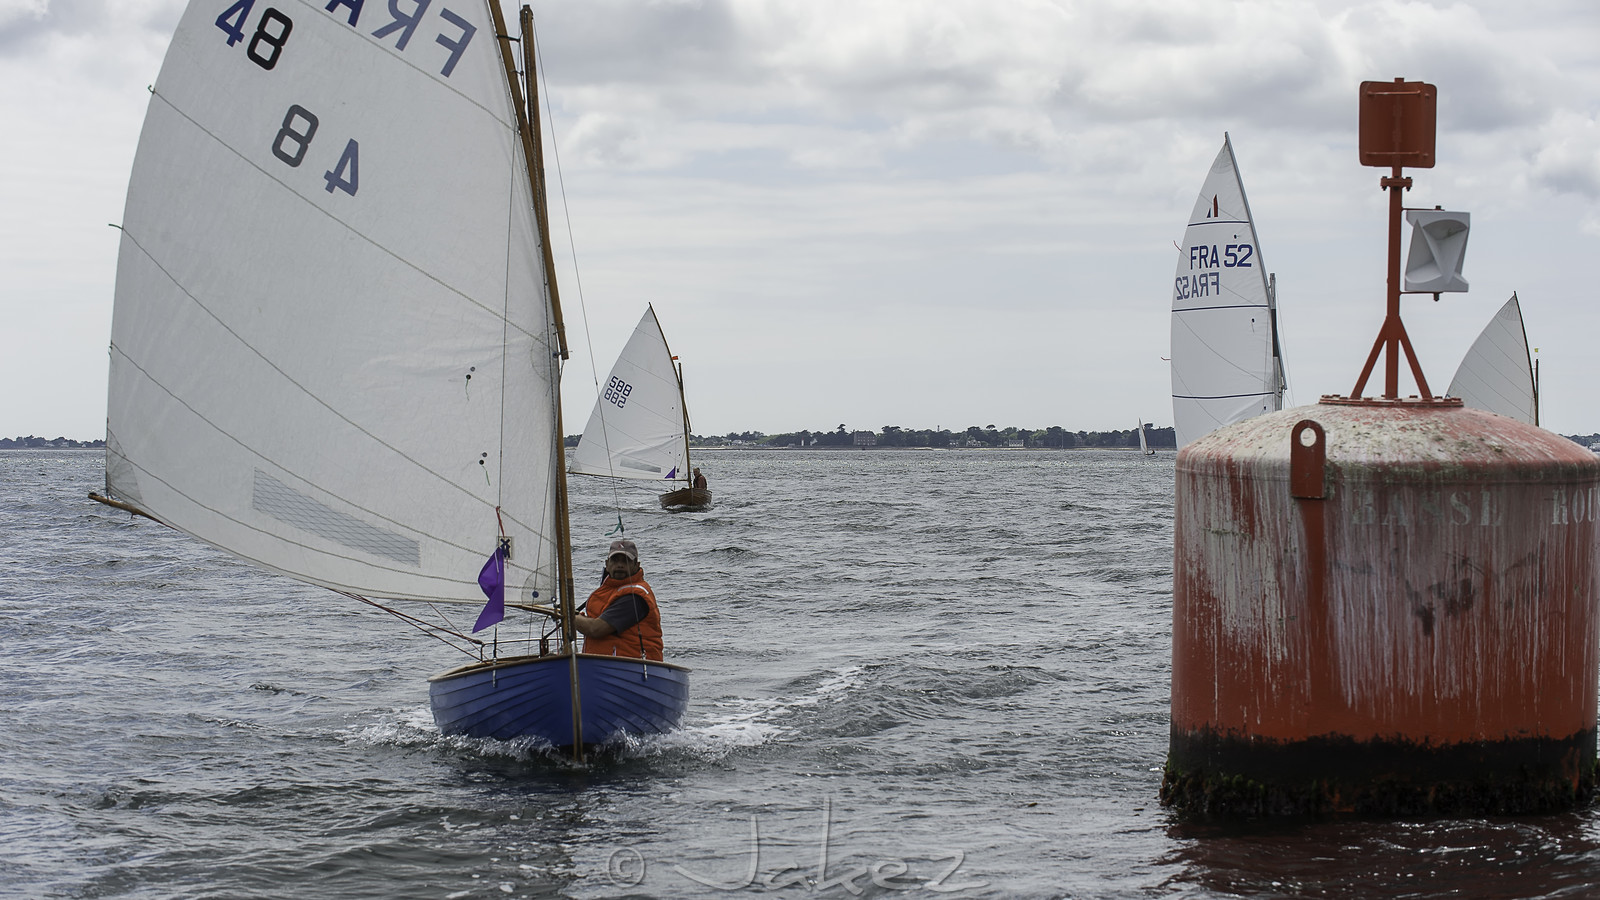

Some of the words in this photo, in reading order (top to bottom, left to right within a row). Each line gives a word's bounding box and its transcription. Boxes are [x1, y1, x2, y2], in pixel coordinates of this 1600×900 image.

[215, 0, 293, 71] 48
[1190, 245, 1220, 270] FRA
[1223, 244, 1253, 268] 52
[609, 375, 633, 397] 588
